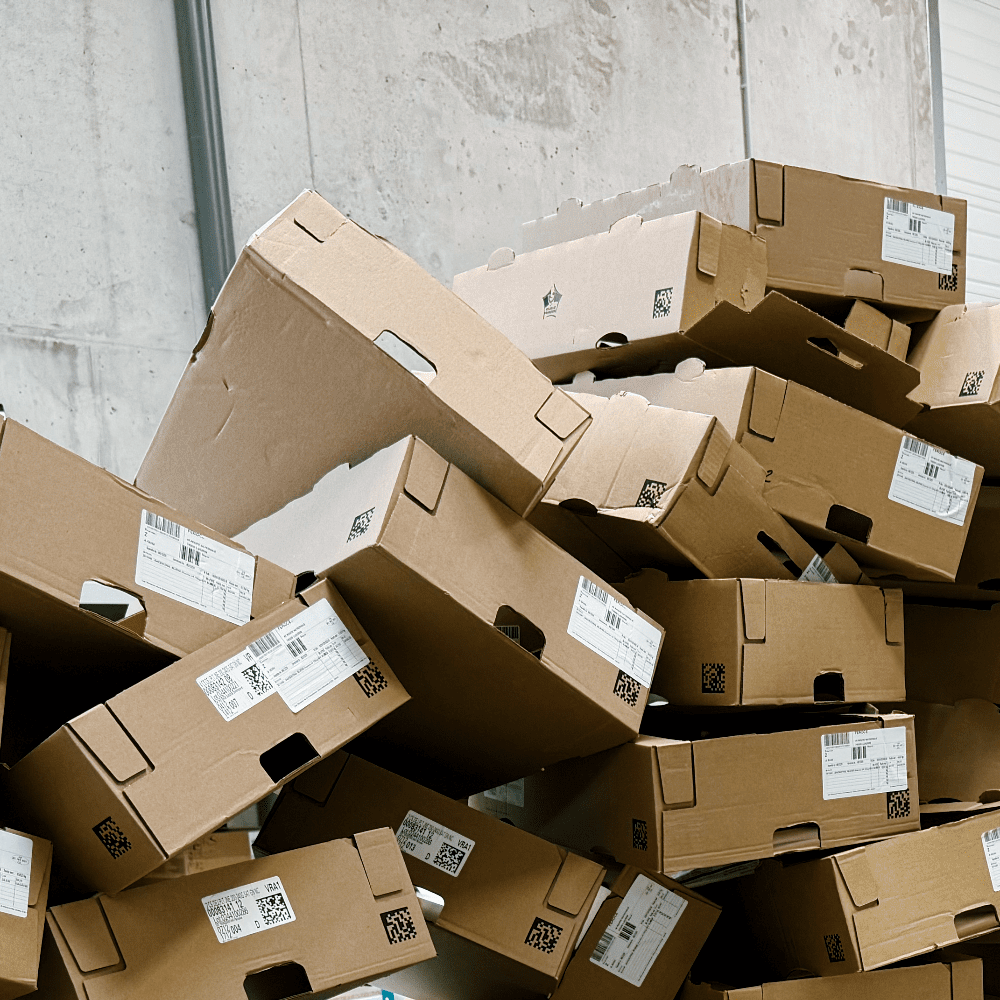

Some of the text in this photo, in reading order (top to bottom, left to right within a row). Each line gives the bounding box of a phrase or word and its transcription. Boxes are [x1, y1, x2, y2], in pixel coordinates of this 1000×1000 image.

[457, 839, 472, 851] VRA1
[264, 881, 281, 893] VRA1
[231, 924, 242, 935] 004
[254, 920, 261, 929] D
